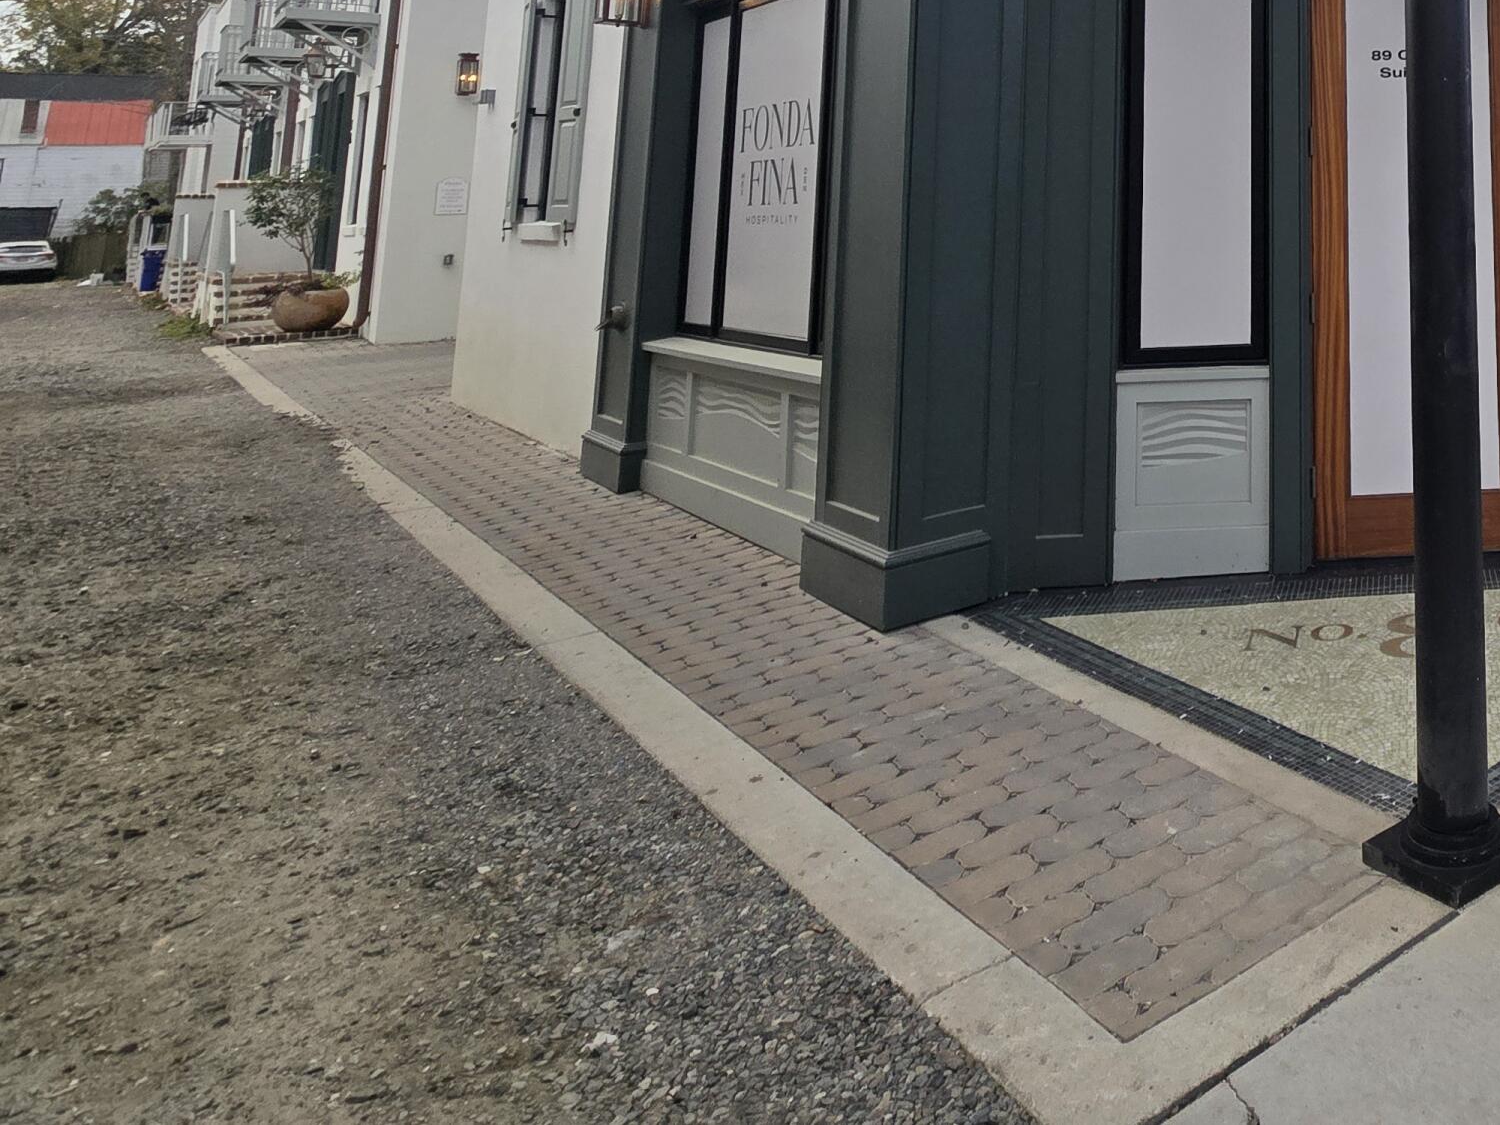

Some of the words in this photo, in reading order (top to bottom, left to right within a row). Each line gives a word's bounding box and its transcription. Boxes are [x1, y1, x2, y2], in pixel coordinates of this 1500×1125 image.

[1371, 49, 1392, 61] 89
[740, 98, 815, 153] FONDA
[747, 157, 798, 206] FINA
[745, 214, 797, 225] HOSPITALITY
